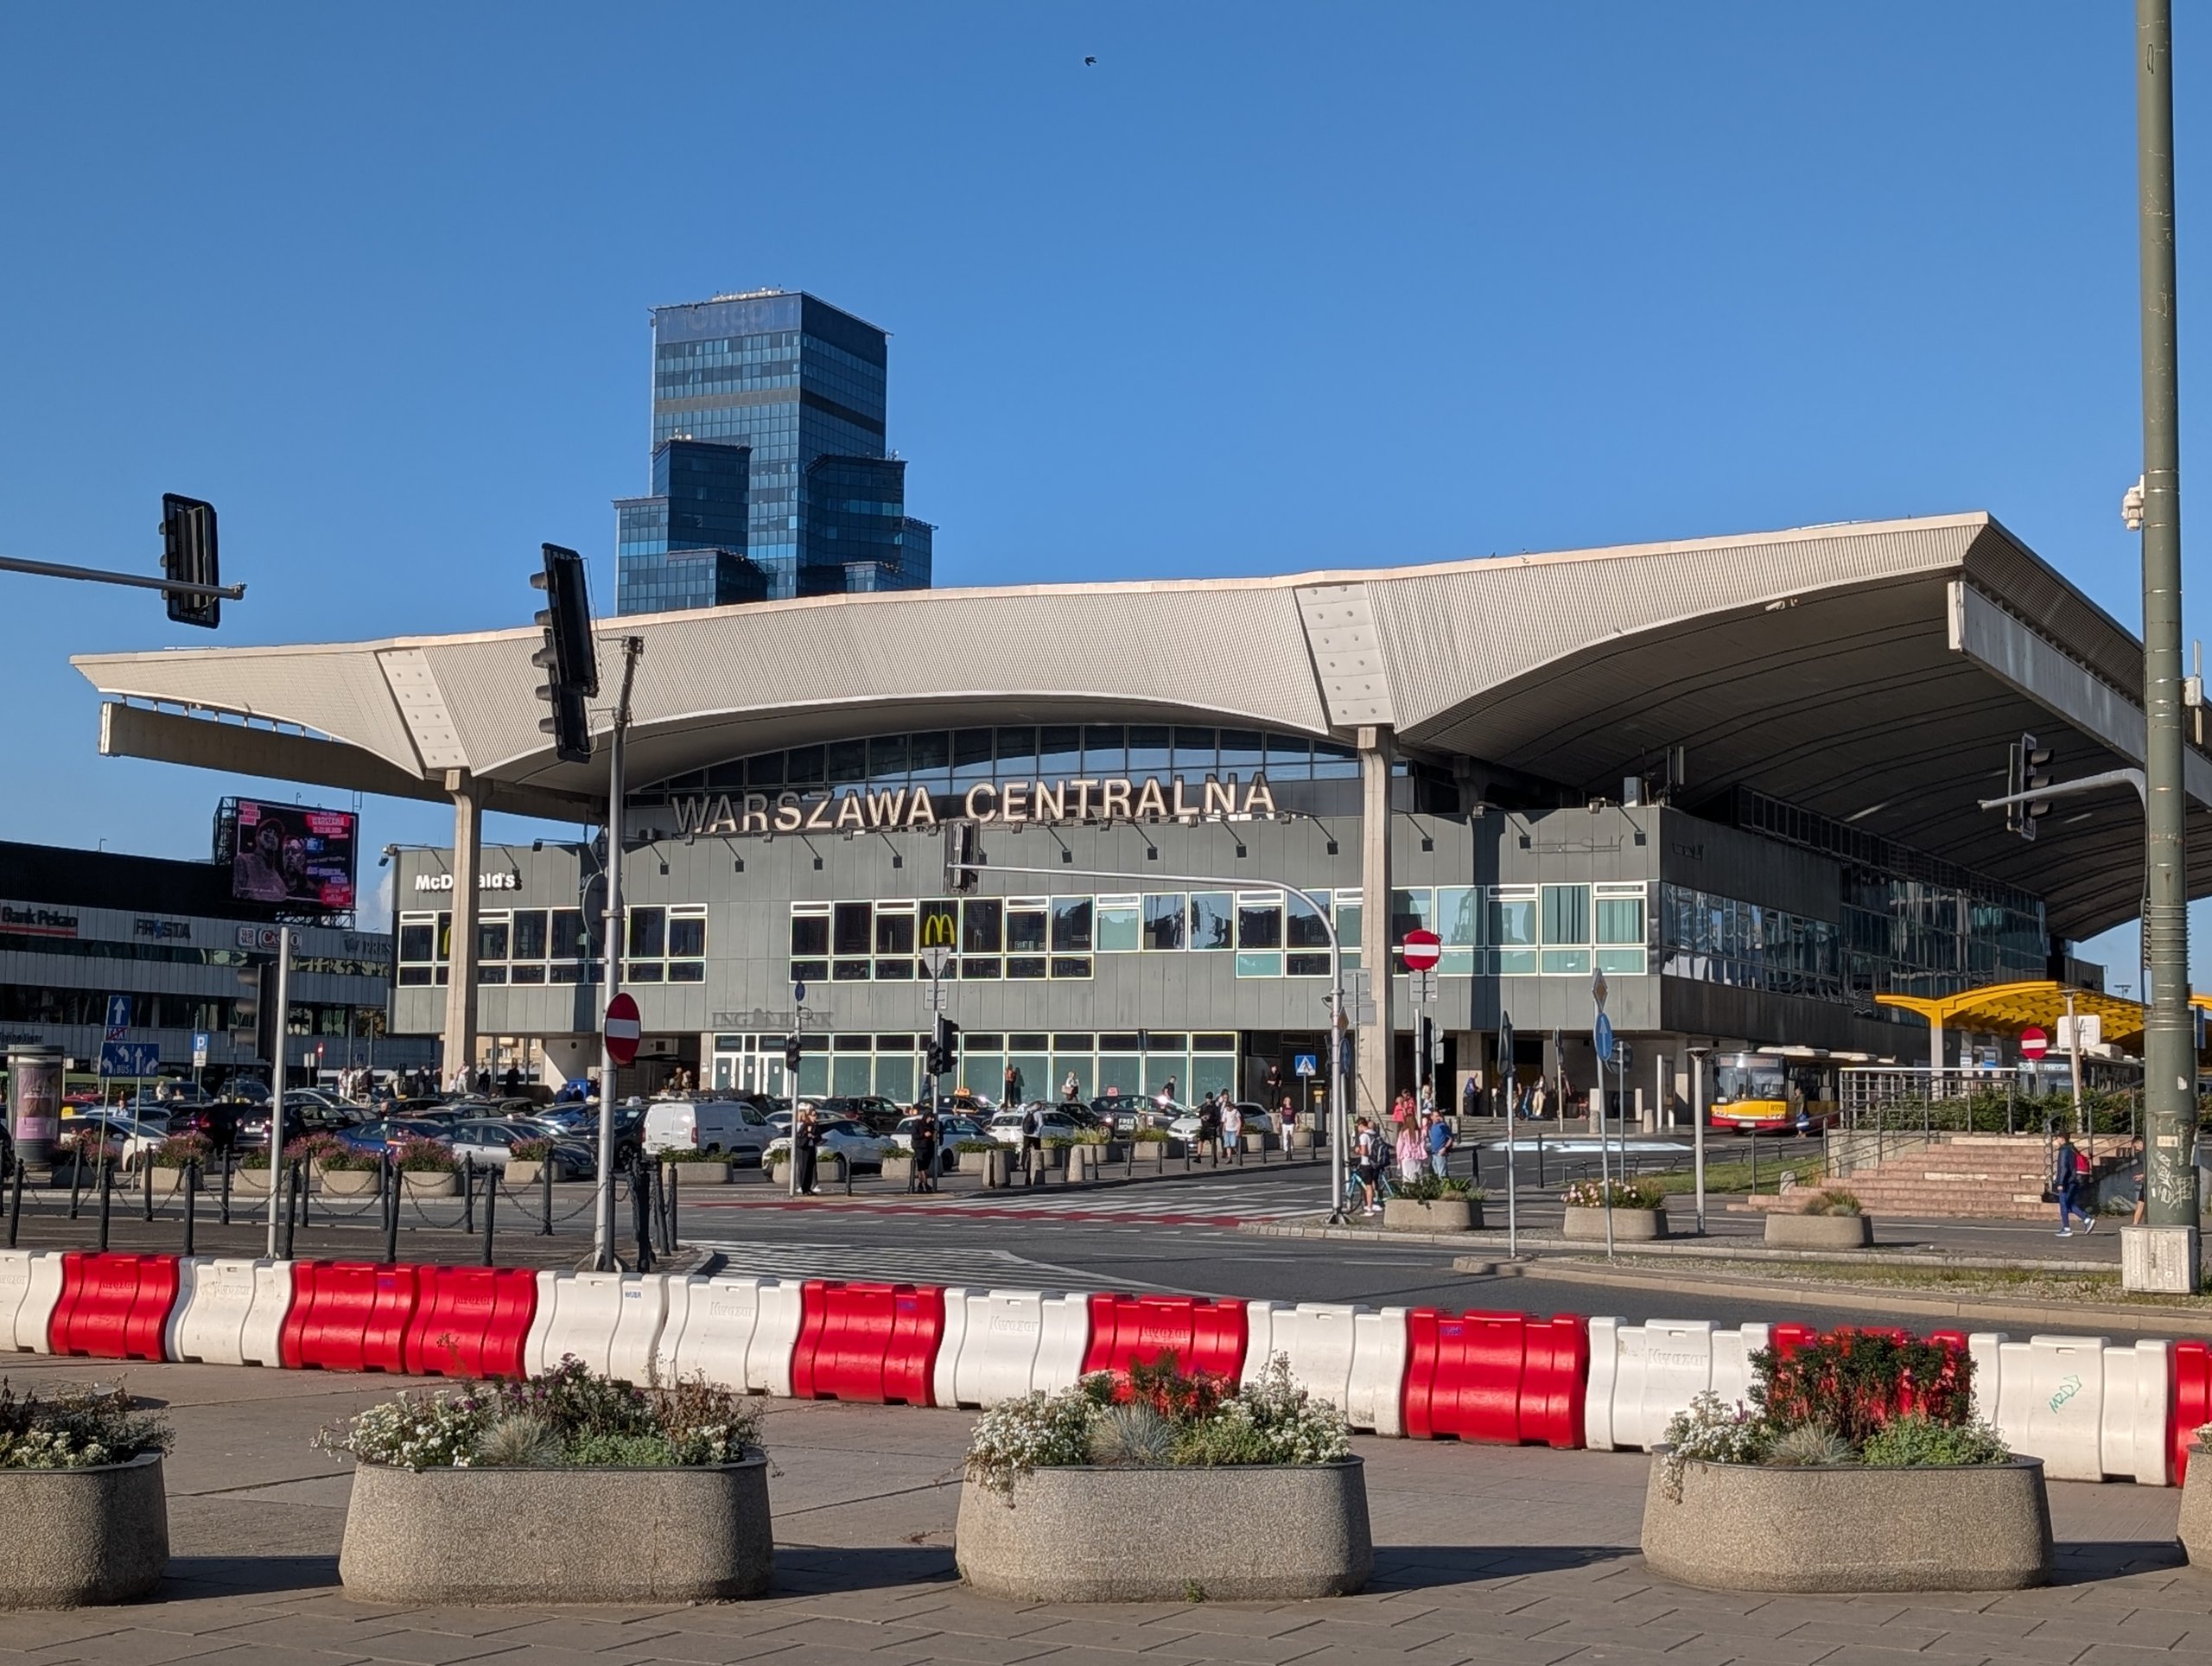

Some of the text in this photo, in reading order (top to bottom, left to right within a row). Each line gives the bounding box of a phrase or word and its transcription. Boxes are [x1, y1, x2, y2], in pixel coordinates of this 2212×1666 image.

[671, 771, 1277, 834] WARSZAWA CENTRALNA
[415, 872, 516, 891] McDald's
[196, 1036, 206, 1050] P
[116, 1065, 130, 1074] BUS
[1648, 1348, 1708, 1366] Kwazar
